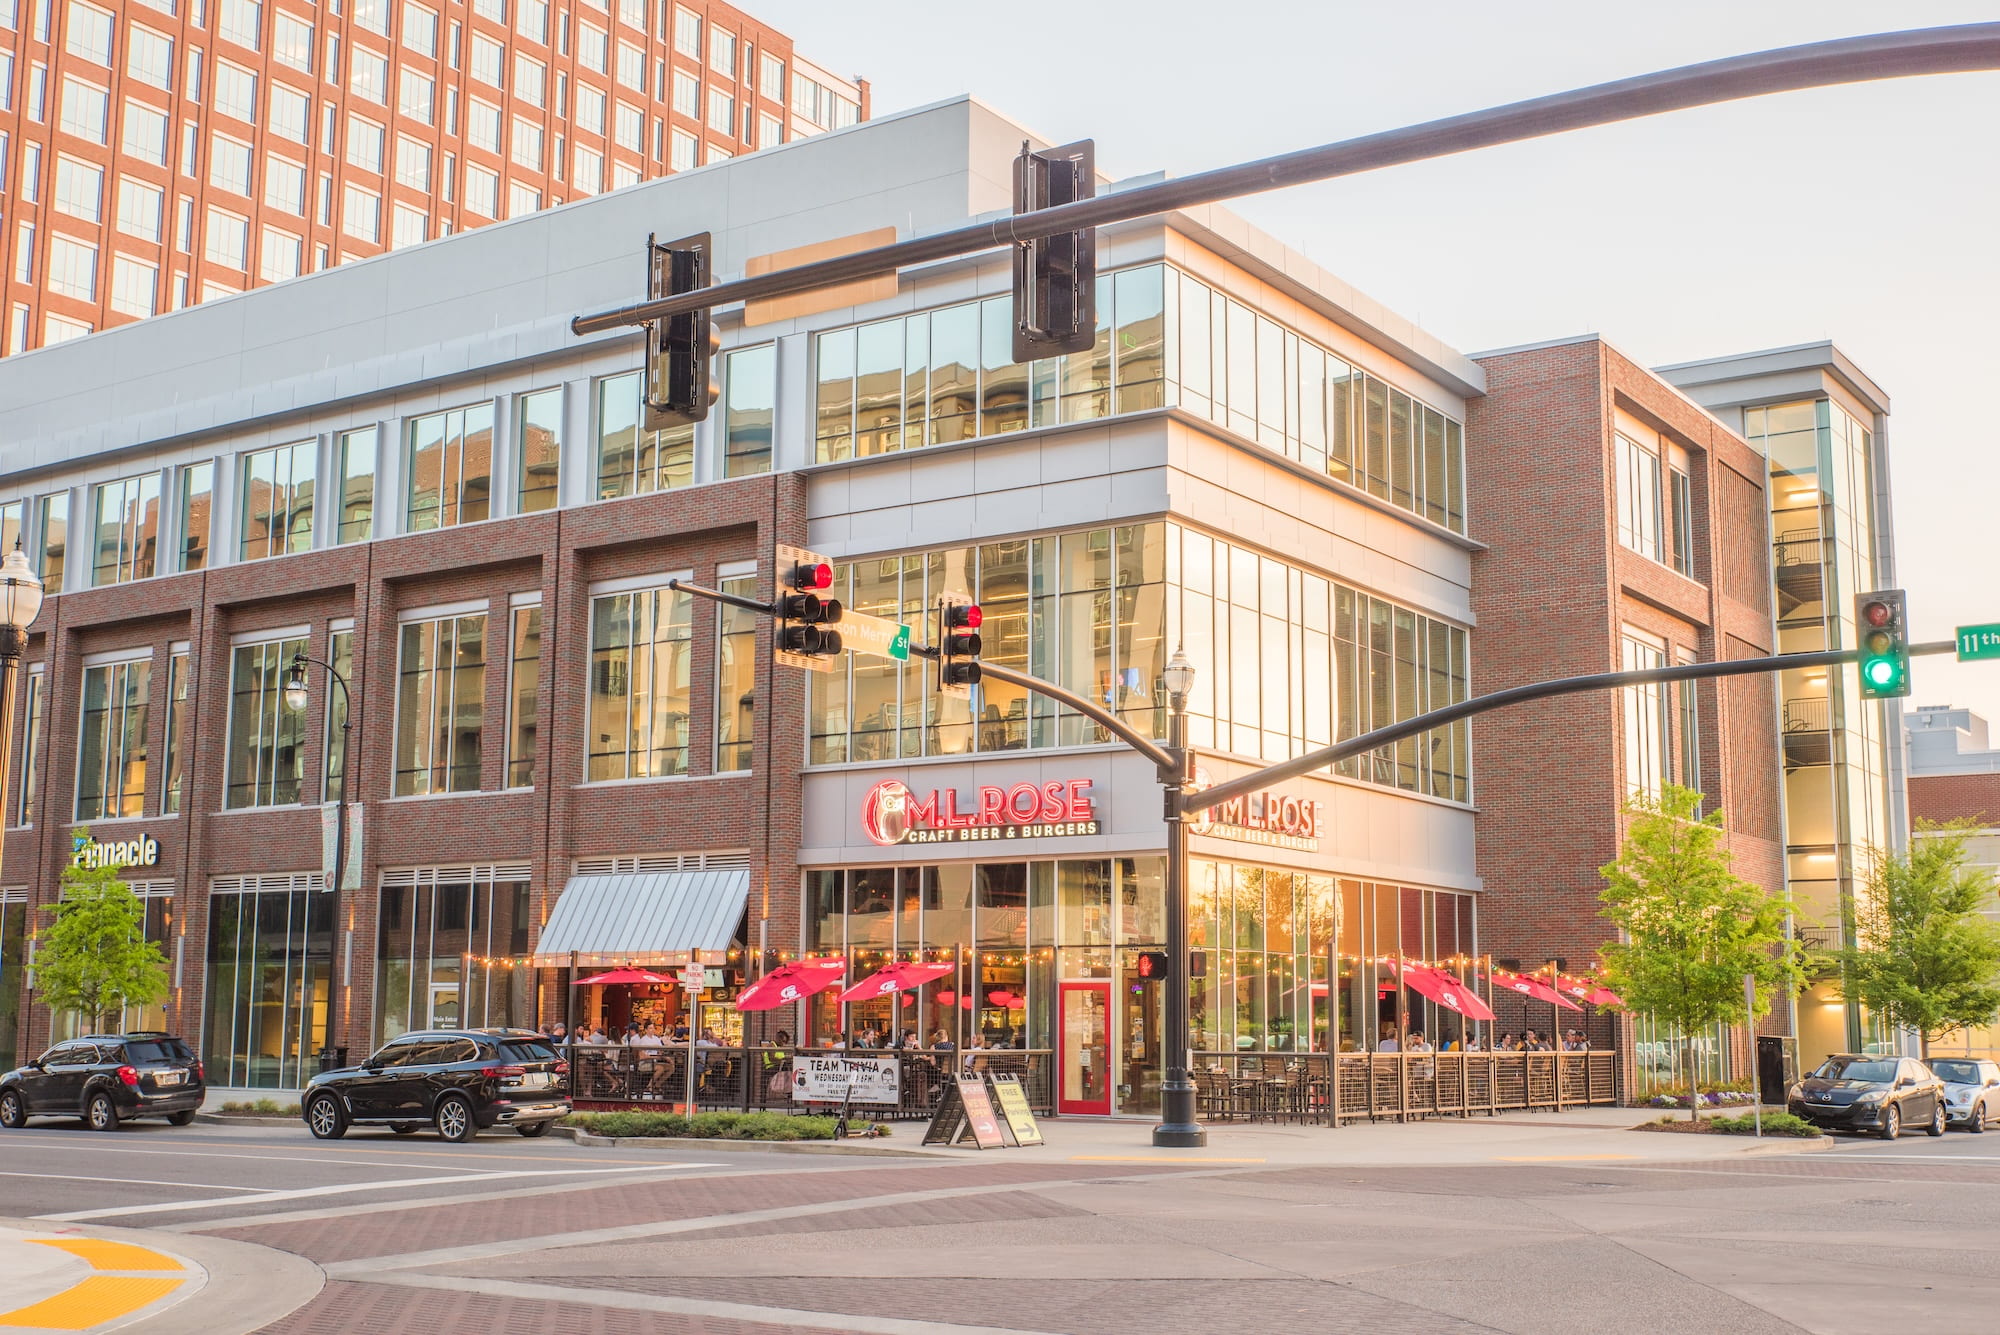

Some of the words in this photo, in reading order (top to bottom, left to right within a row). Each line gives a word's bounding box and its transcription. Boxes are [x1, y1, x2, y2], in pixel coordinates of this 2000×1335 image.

[897, 636, 907, 648] St
[1962, 632, 2000, 652] 11th
[908, 829, 953, 843] CRAFT
[960, 826, 1000, 841] BEER
[1006, 826, 1015, 839] &
[1022, 821, 1097, 838] BURGERS
[1213, 824, 1242, 838] CRAFT
[1245, 829, 1269, 844] BEER
[810, 1060, 839, 1071] TEAM
[814, 1073, 851, 1082] WEDNESDAY
